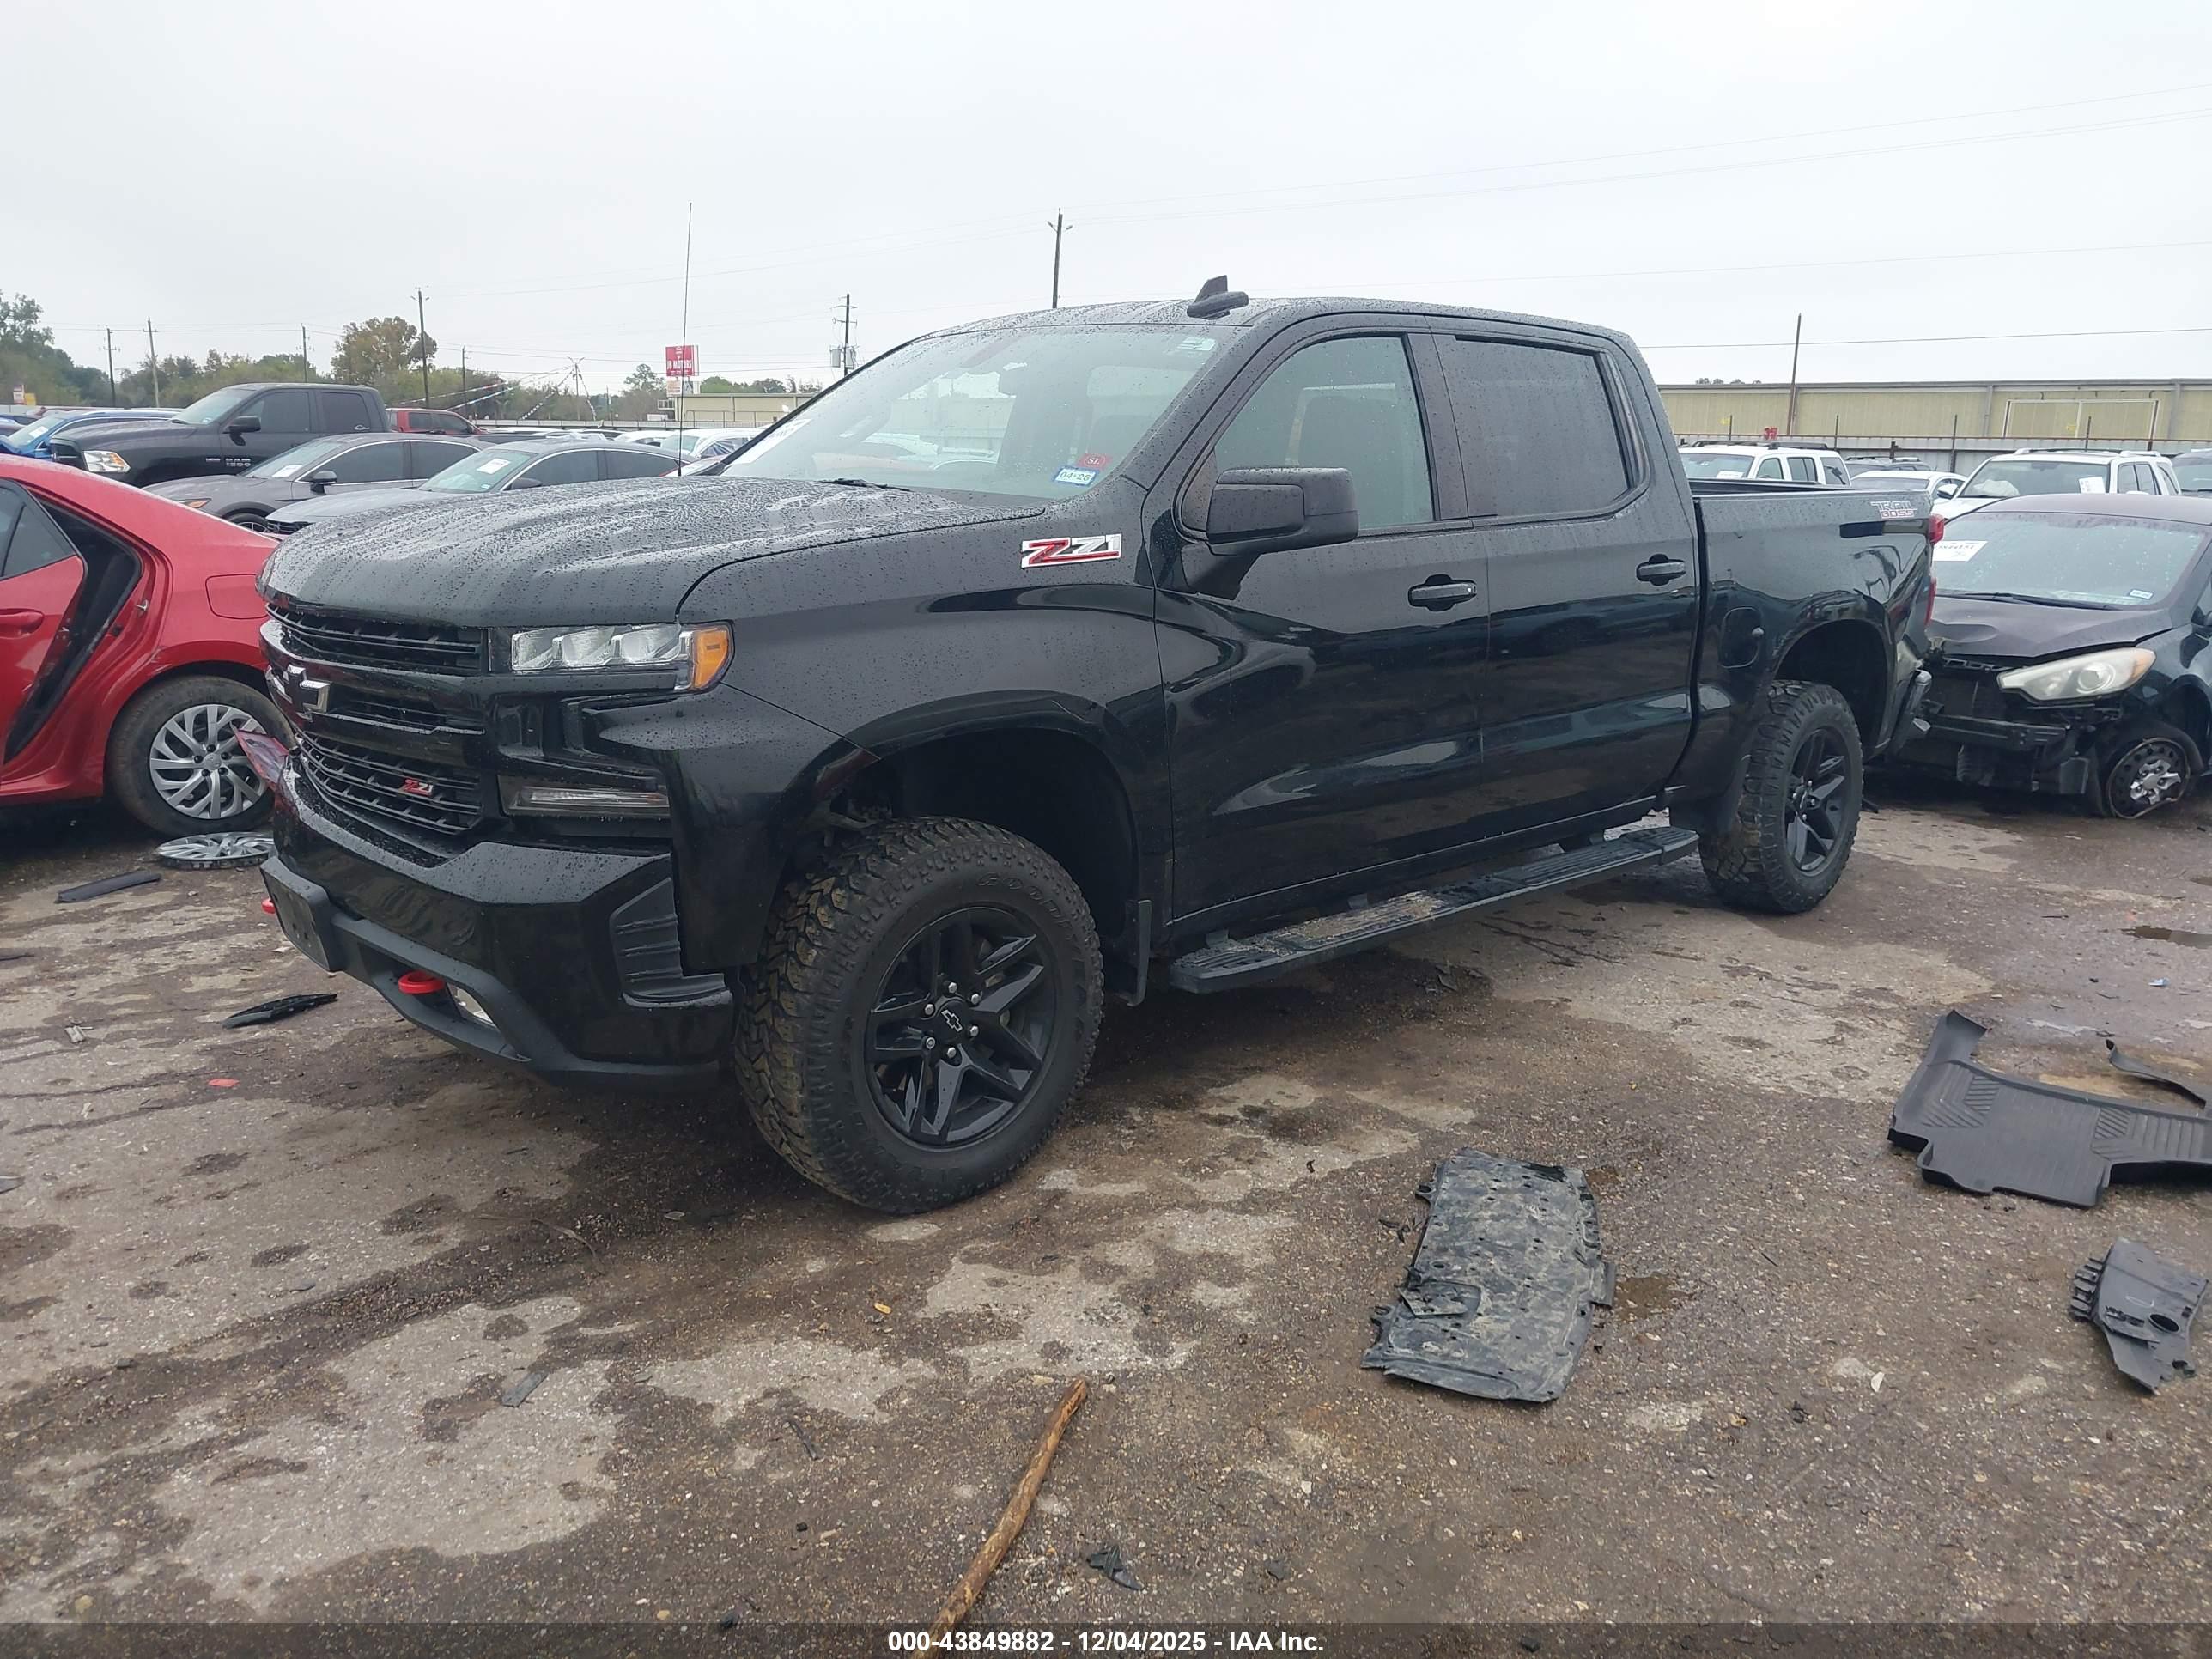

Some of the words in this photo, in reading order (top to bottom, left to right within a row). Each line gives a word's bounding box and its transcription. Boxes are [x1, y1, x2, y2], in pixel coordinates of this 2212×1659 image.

[1870, 501, 1917, 511] TRAIL
[1021, 533, 1122, 568] Z71
[400, 779, 434, 795] Z71
